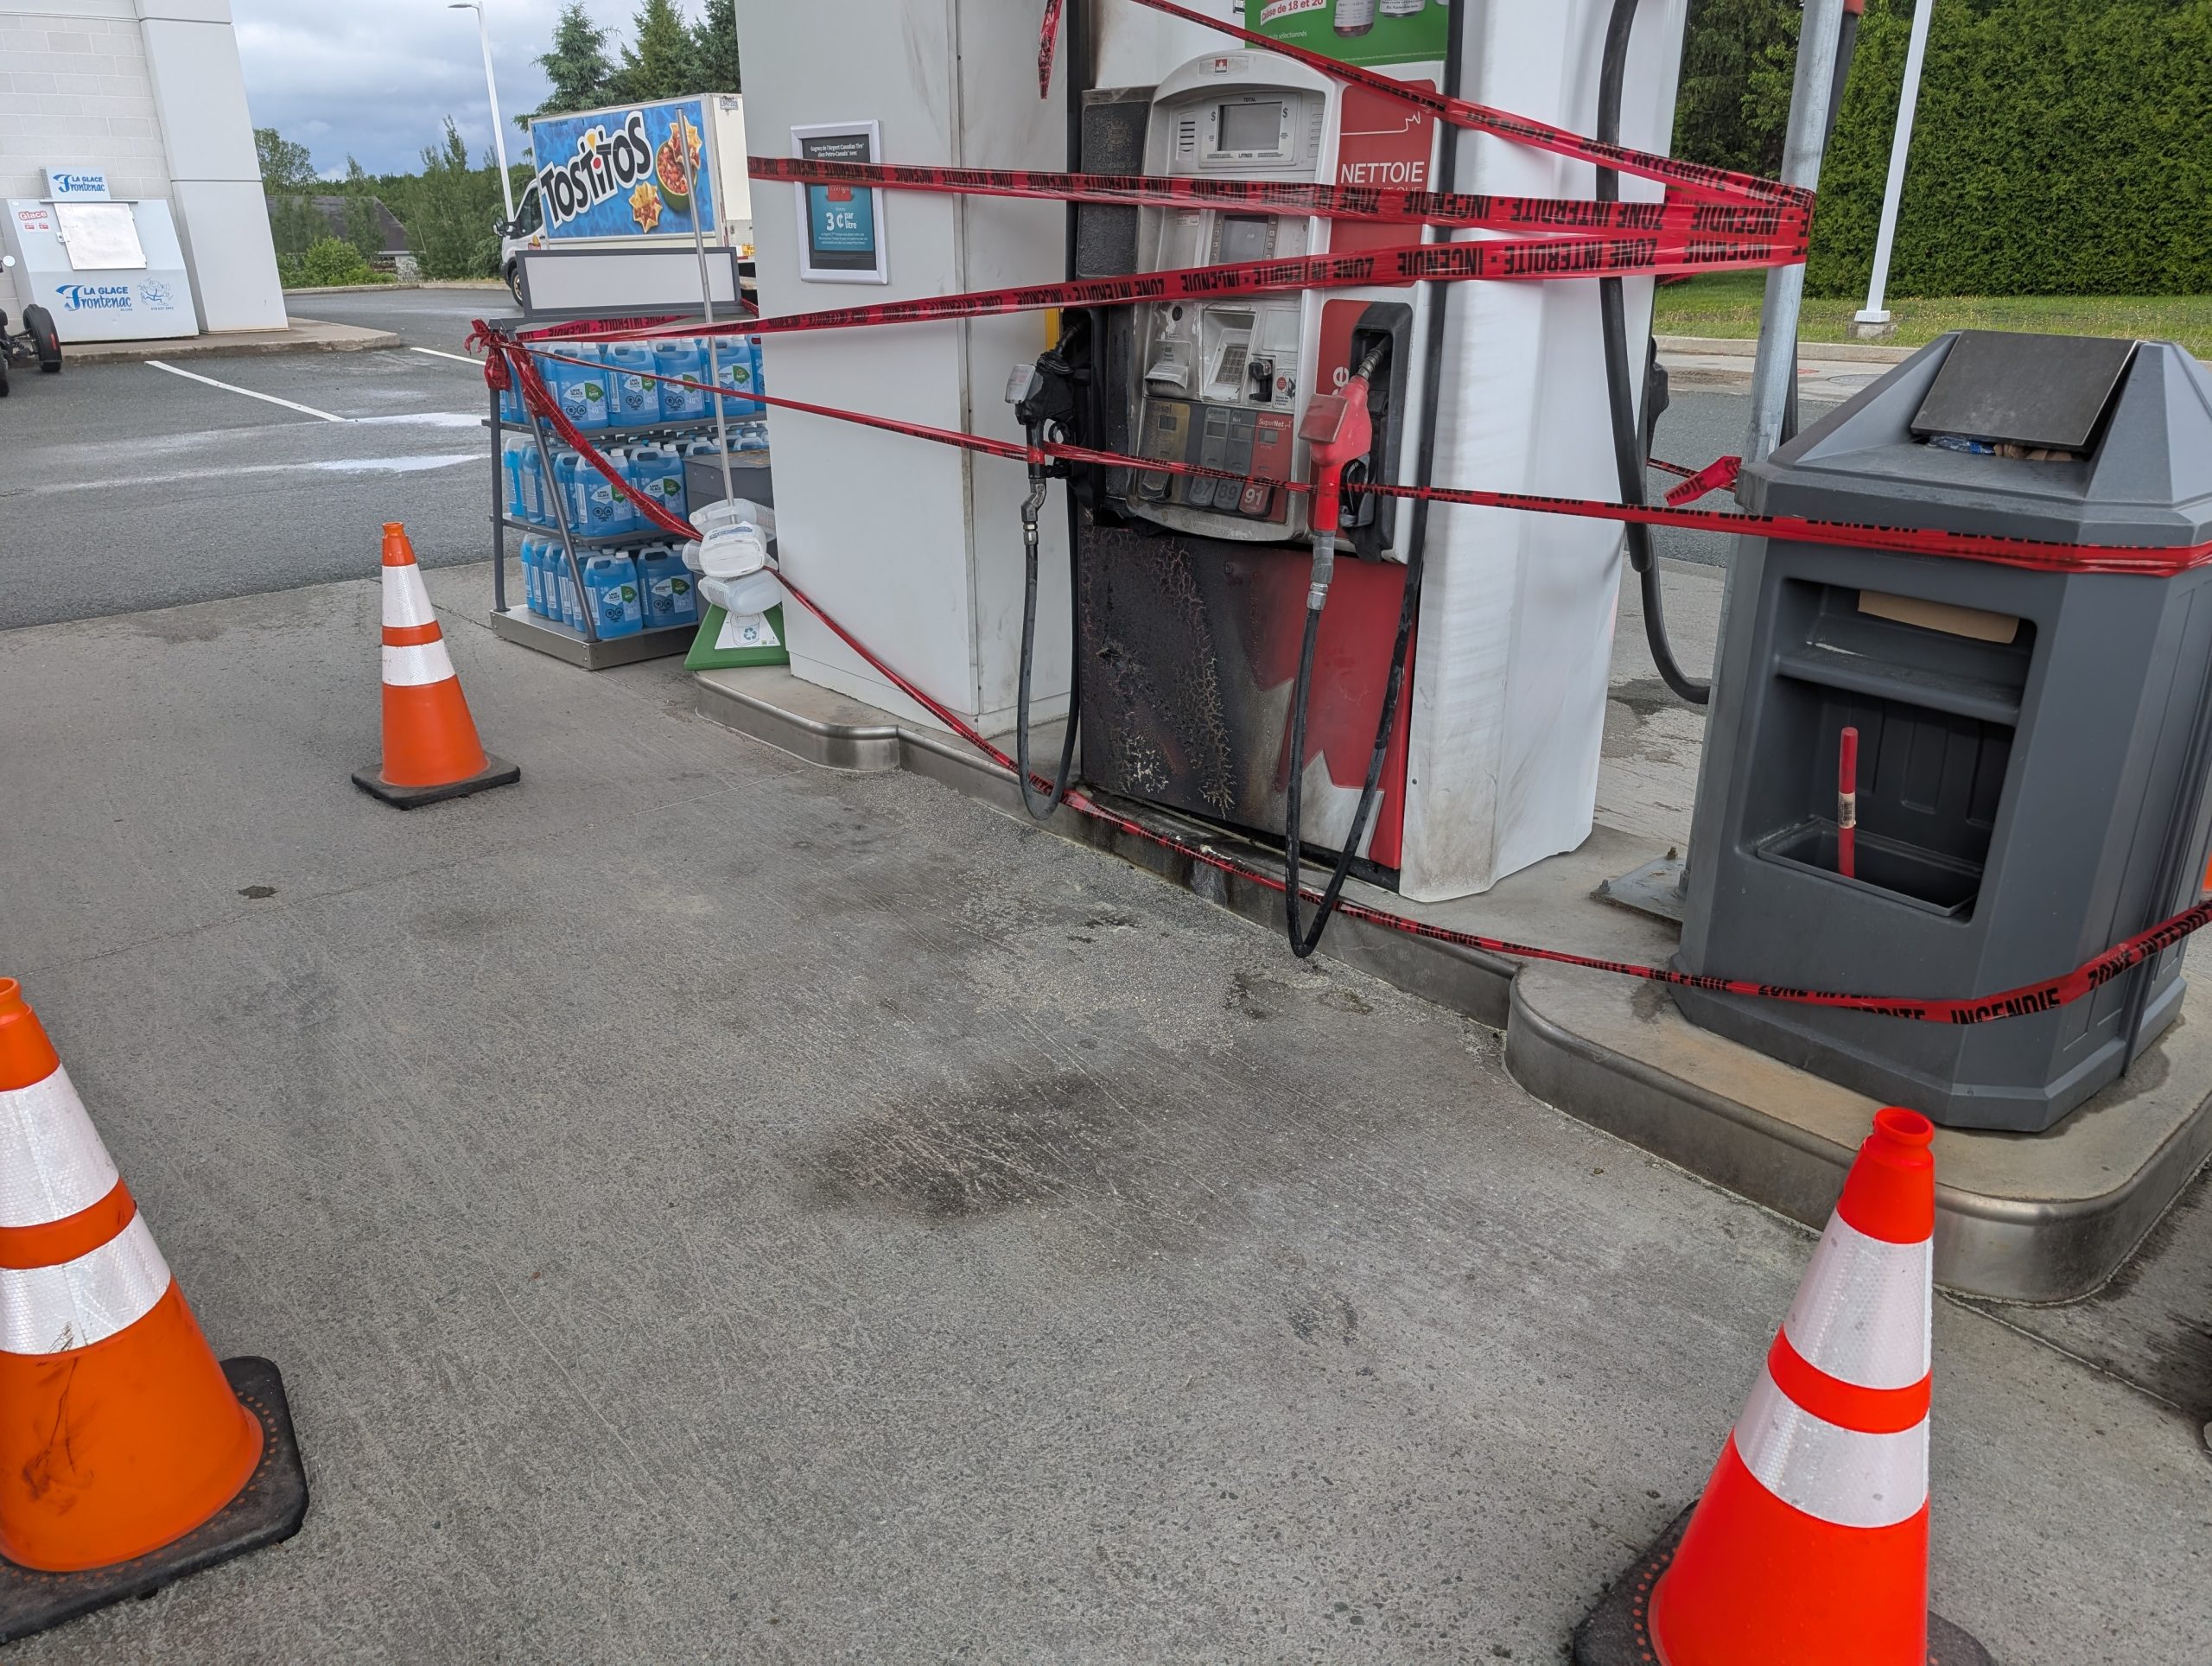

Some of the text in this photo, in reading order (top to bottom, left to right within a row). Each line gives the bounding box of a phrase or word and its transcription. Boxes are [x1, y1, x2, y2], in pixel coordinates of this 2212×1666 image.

[1277, 4, 1287, 14] de
[1288, 1, 1298, 10] 18
[1282, 107, 1288, 118] $
[1341, 162, 1425, 184] NETTOIE
[19, 211, 48, 220] Glace
[1690, 205, 1783, 235] INCENDIE
[1397, 247, 1484, 277] INCENDIE
[1503, 240, 1604, 275] INTERDITE
[1608, 238, 1658, 270] ZONE
[56, 285, 132, 311] Frontenac
[1258, 418, 1285, 427] SuperNet
[1193, 481, 1213, 496] 87
[1218, 484, 1237, 499] 89
[1244, 488, 1263, 505] 91
[1950, 987, 2061, 1024] INCENDIE
